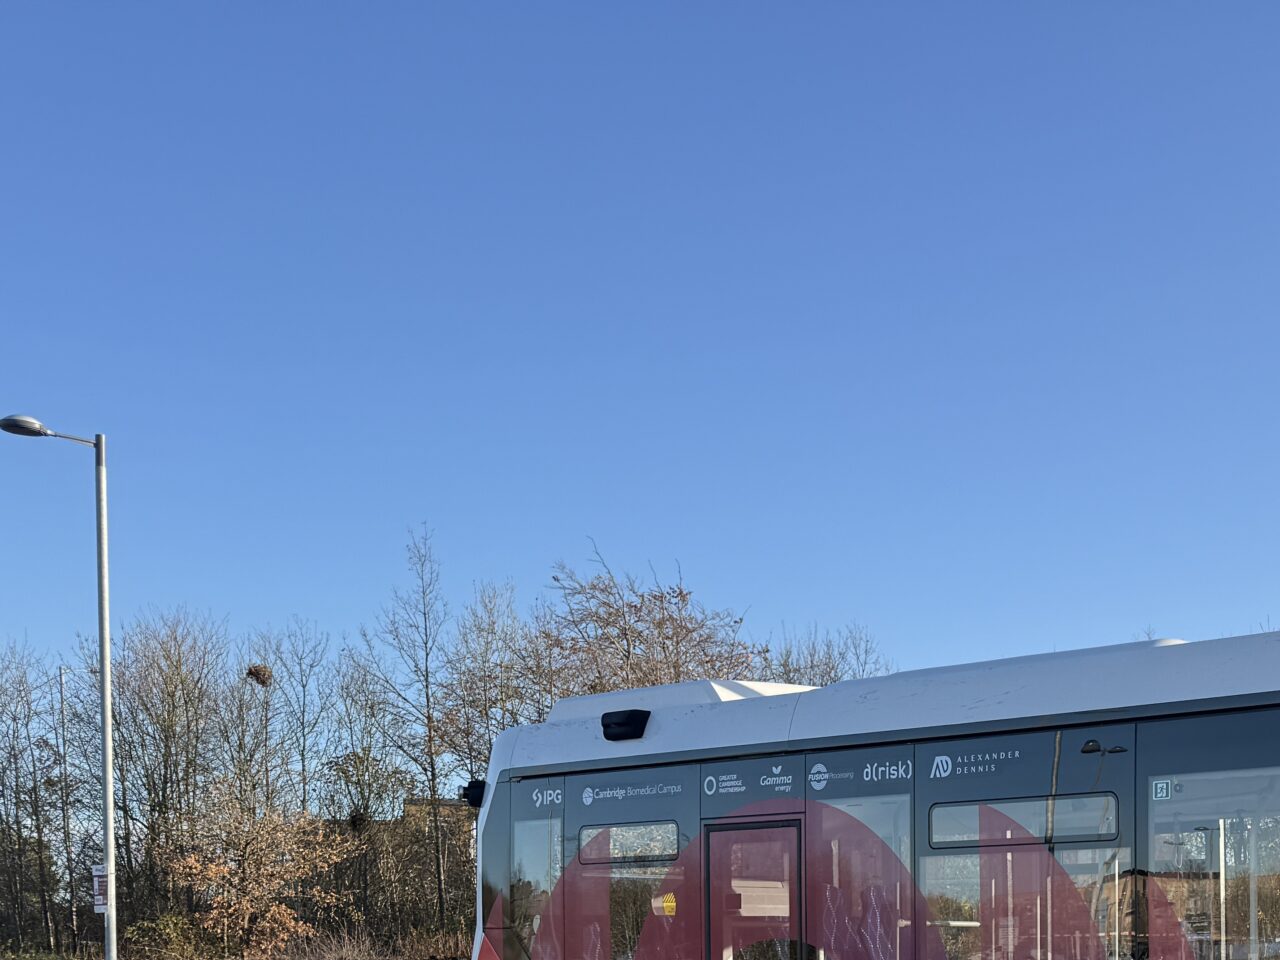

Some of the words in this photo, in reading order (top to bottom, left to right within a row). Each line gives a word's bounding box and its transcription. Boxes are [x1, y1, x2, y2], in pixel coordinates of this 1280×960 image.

[956, 750, 1021, 763] ALEXANDER
[956, 764, 997, 775] DENNIS
[760, 775, 793, 786] Gamma
[808, 772, 830, 781] FUSION
[593, 786, 626, 800] Cambridge
[626, 784, 658, 796] Biomedical
[657, 783, 682, 795] Campus
[718, 786, 747, 794] PARTNERSHIP
[774, 785, 792, 793] energy
[543, 789, 562, 805] IPG
